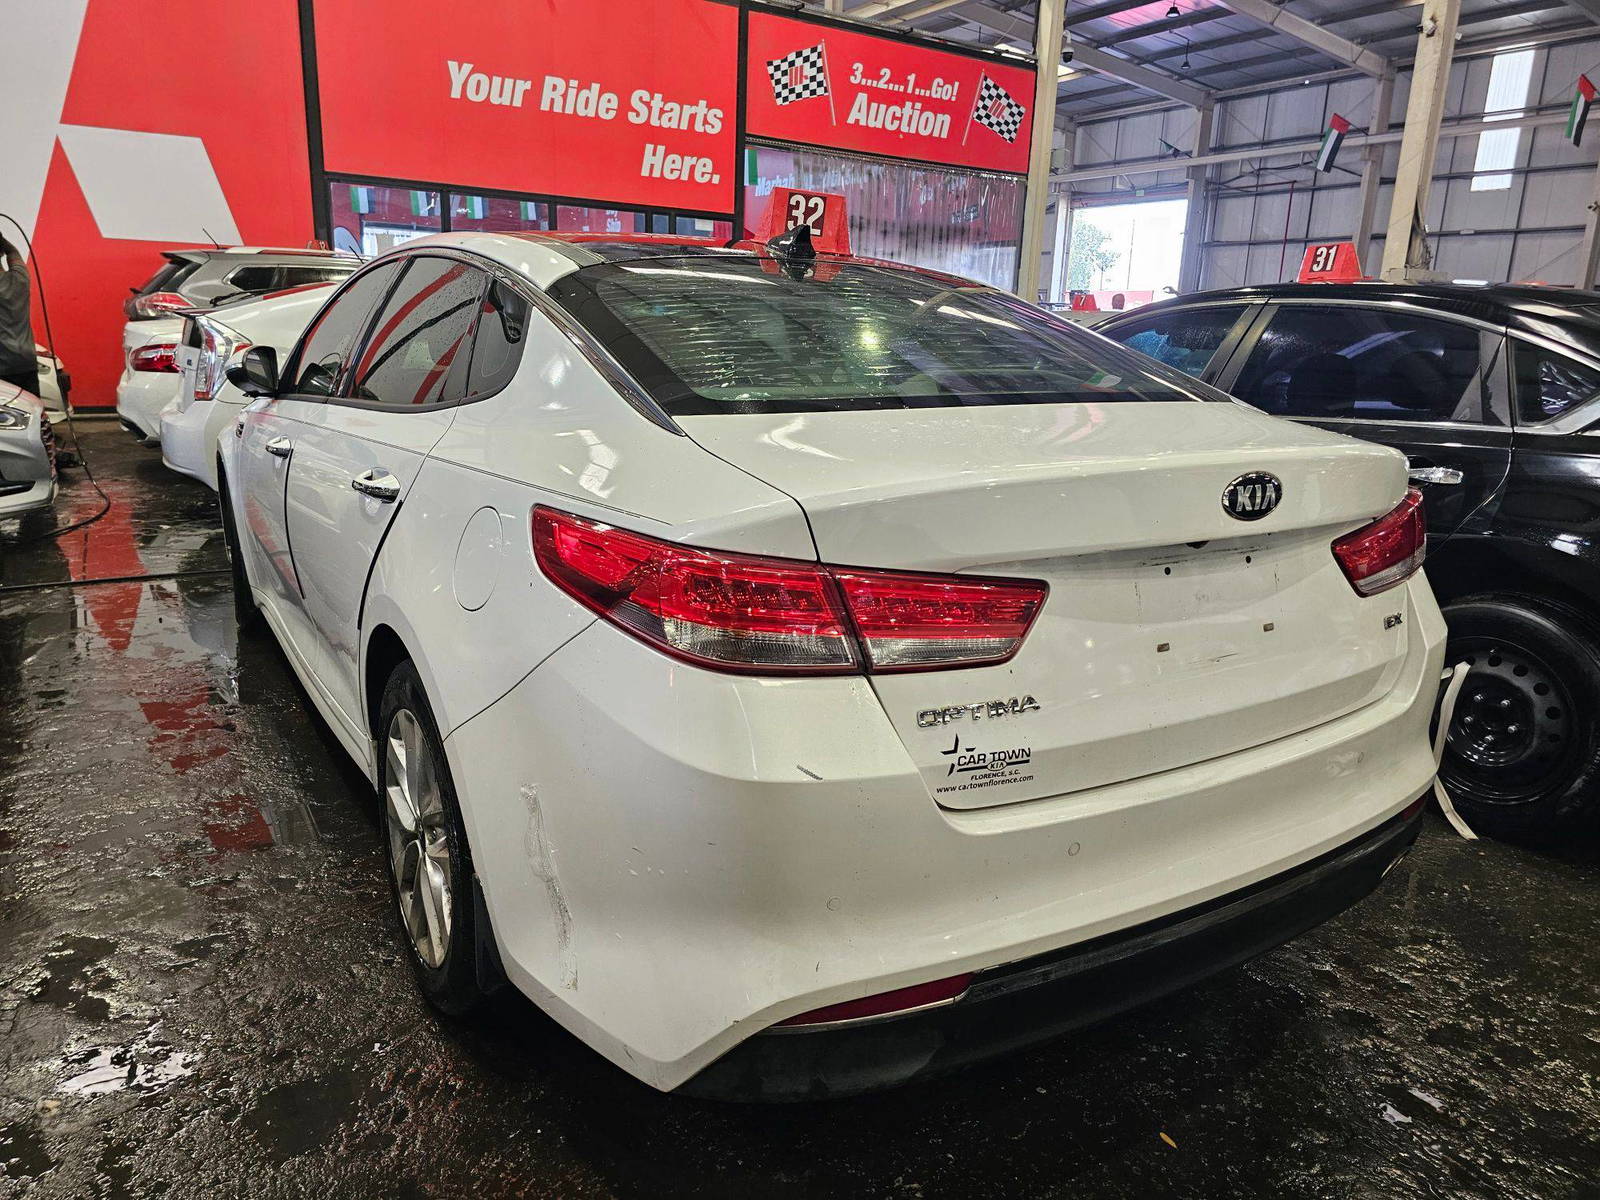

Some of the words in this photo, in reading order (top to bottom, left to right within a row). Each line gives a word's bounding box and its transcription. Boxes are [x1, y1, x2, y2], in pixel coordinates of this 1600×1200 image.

[447, 61, 532, 108] Your
[540, 75, 619, 121] Ride
[627, 89, 724, 135] Starts
[846, 92, 951, 139] Auction
[641, 143, 721, 185] Here.
[787, 194, 825, 236] 32
[1312, 245, 1338, 272] 31
[1079, 295, 1086, 307] 7
[1235, 483, 1276, 512] KIA
[1383, 612, 1403, 631] EX
[916, 694, 1041, 728] OPTIMA
[957, 753, 986, 767] CAR
[989, 747, 1031, 763] TOWN
[936, 775, 1034, 794] wwwcartownflorence.com
